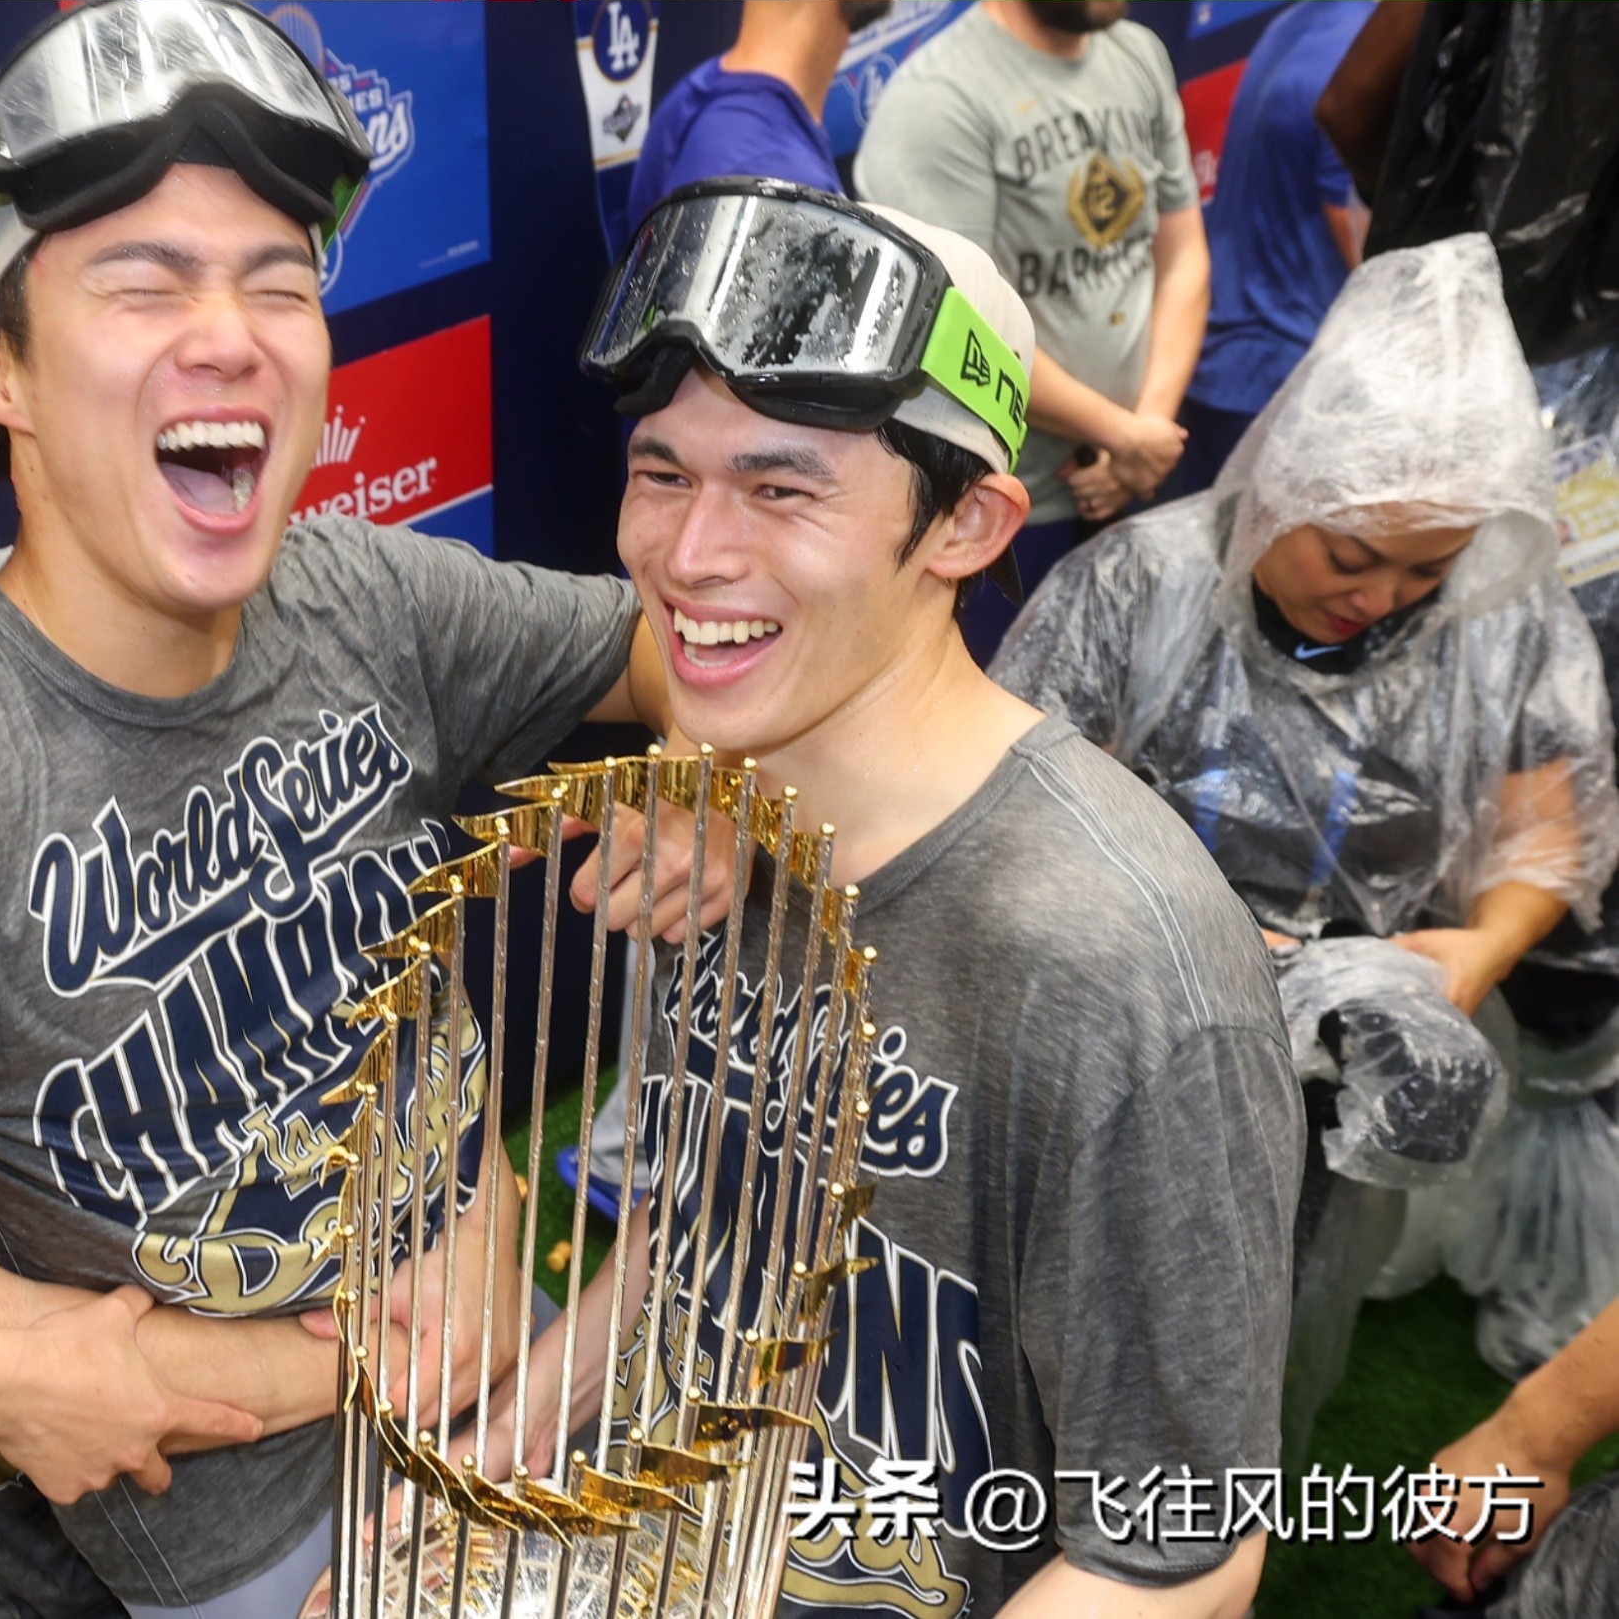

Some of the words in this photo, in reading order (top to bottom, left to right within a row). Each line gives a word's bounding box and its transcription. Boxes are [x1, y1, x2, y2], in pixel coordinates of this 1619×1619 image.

[607, 1, 640, 73] LA
[289, 456, 438, 521] weiser
[28, 765, 267, 998] World
[239, 701, 414, 921] Series
